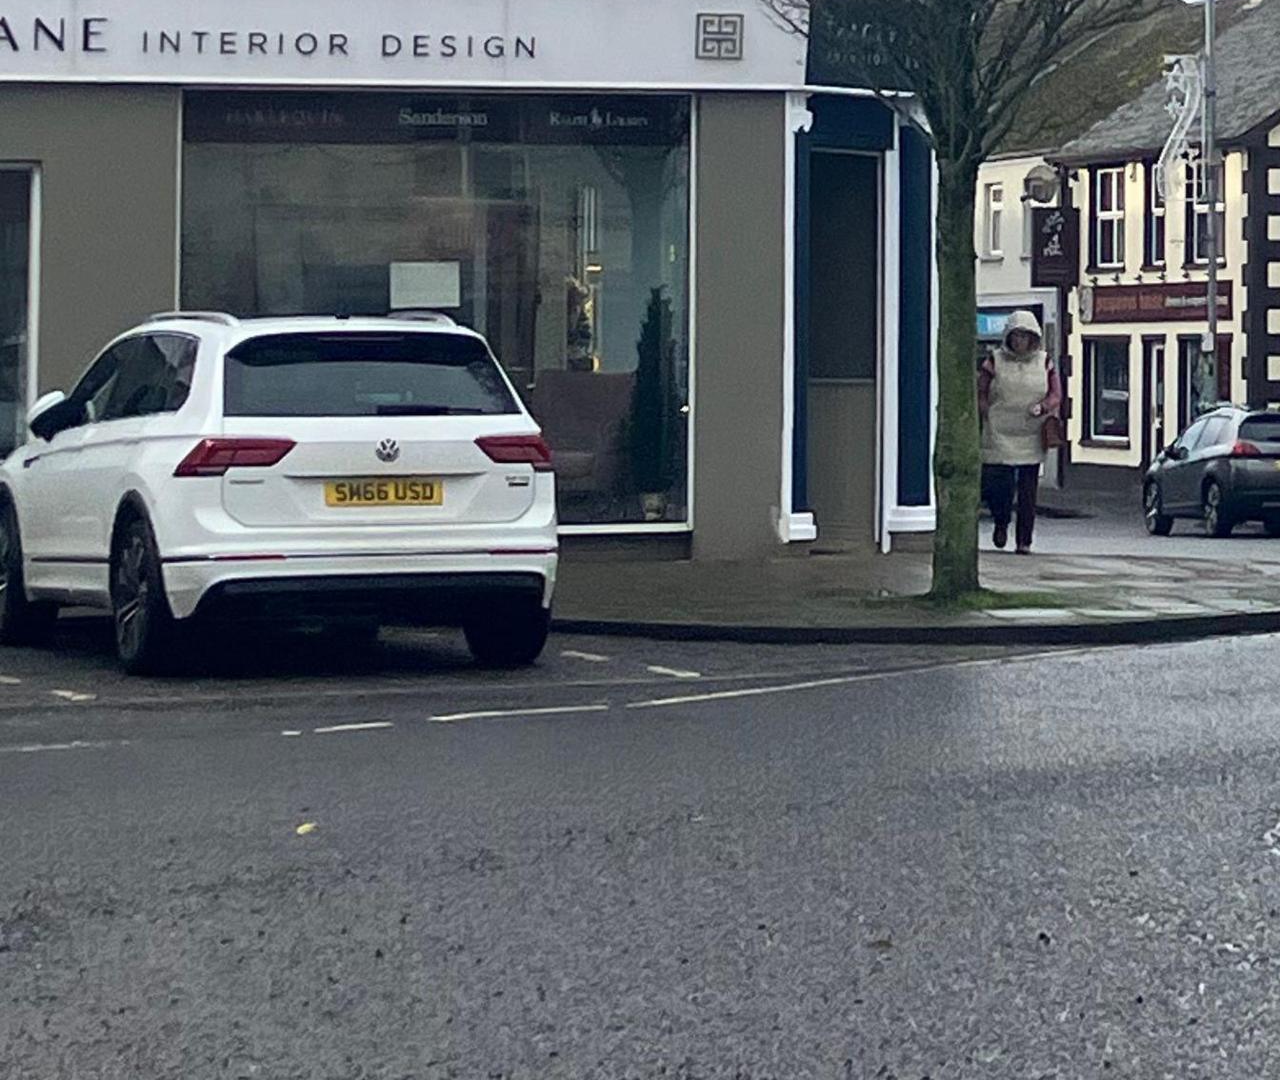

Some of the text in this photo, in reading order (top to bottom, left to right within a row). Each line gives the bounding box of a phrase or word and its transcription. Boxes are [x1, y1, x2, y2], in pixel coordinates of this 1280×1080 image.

[142, 30, 349, 56] INTERIOR
[381, 33, 536, 58] DESIGN
[399, 107, 490, 126] Sanderson
